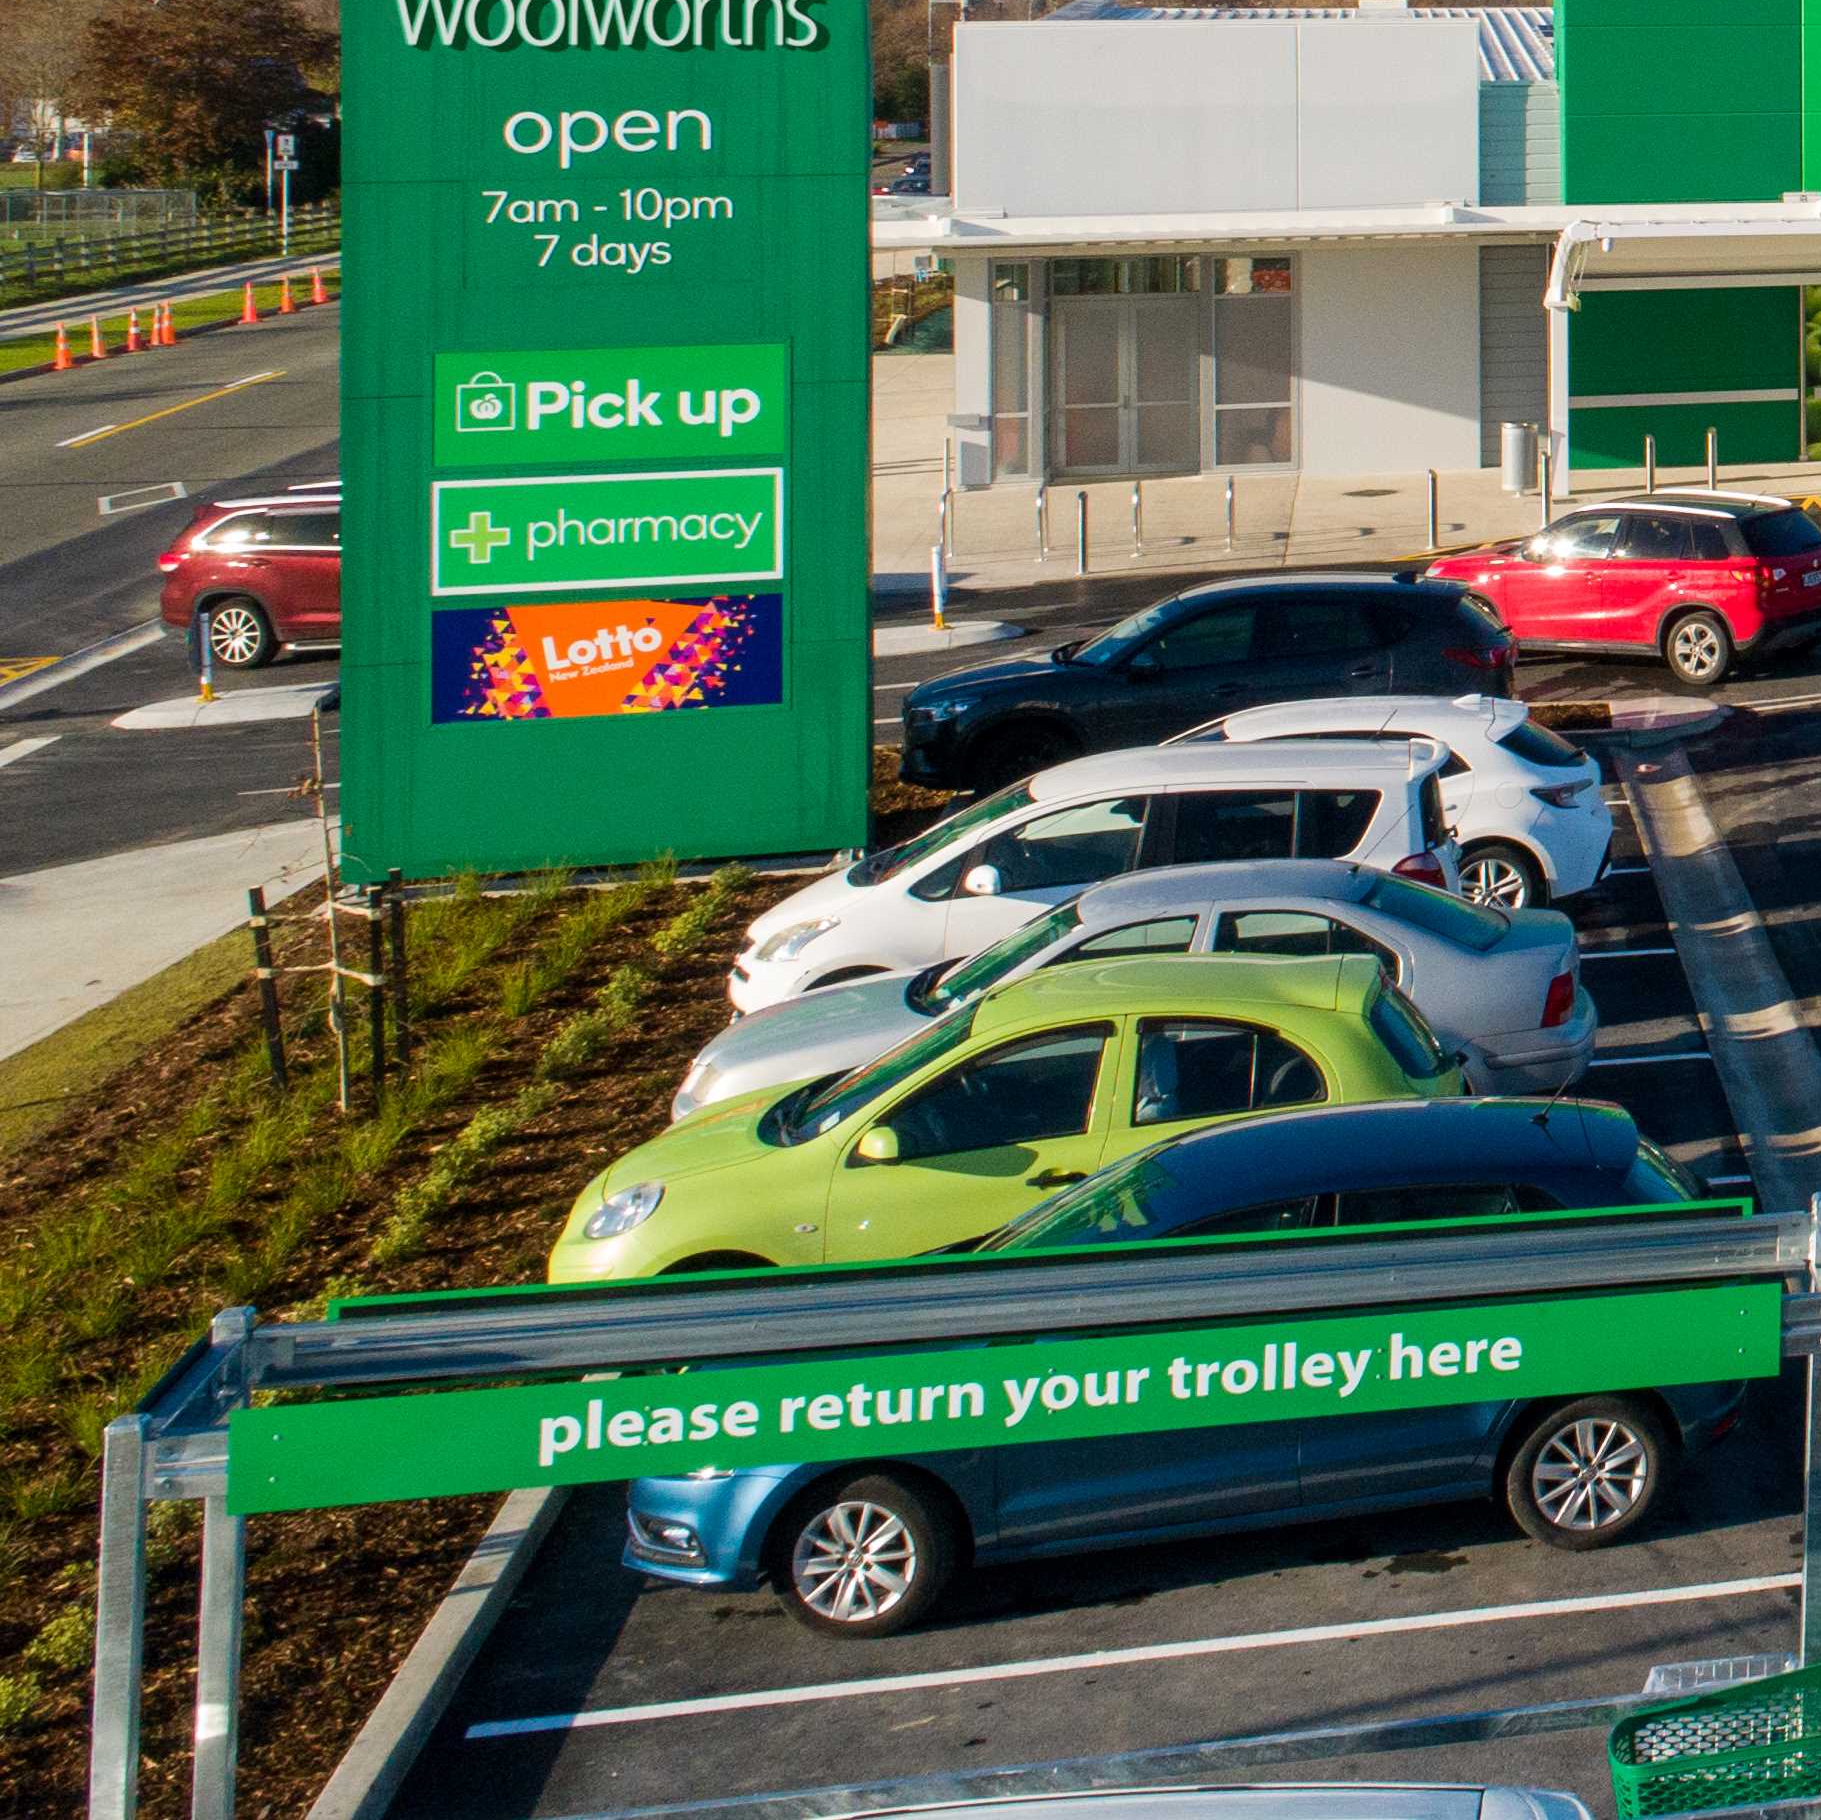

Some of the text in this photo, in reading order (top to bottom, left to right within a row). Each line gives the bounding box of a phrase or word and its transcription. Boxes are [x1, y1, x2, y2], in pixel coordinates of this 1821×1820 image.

[503, 109, 712, 169] open
[482, 190, 579, 224] 7am
[620, 187, 733, 229] 10pm
[533, 234, 672, 274] 7 days
[526, 378, 761, 437] Pick up
[527, 508, 763, 561] pharmacy
[541, 624, 663, 671] Lotto
[548, 656, 635, 683] New Zealand
[538, 1332, 1523, 1467] please return your trolley here
